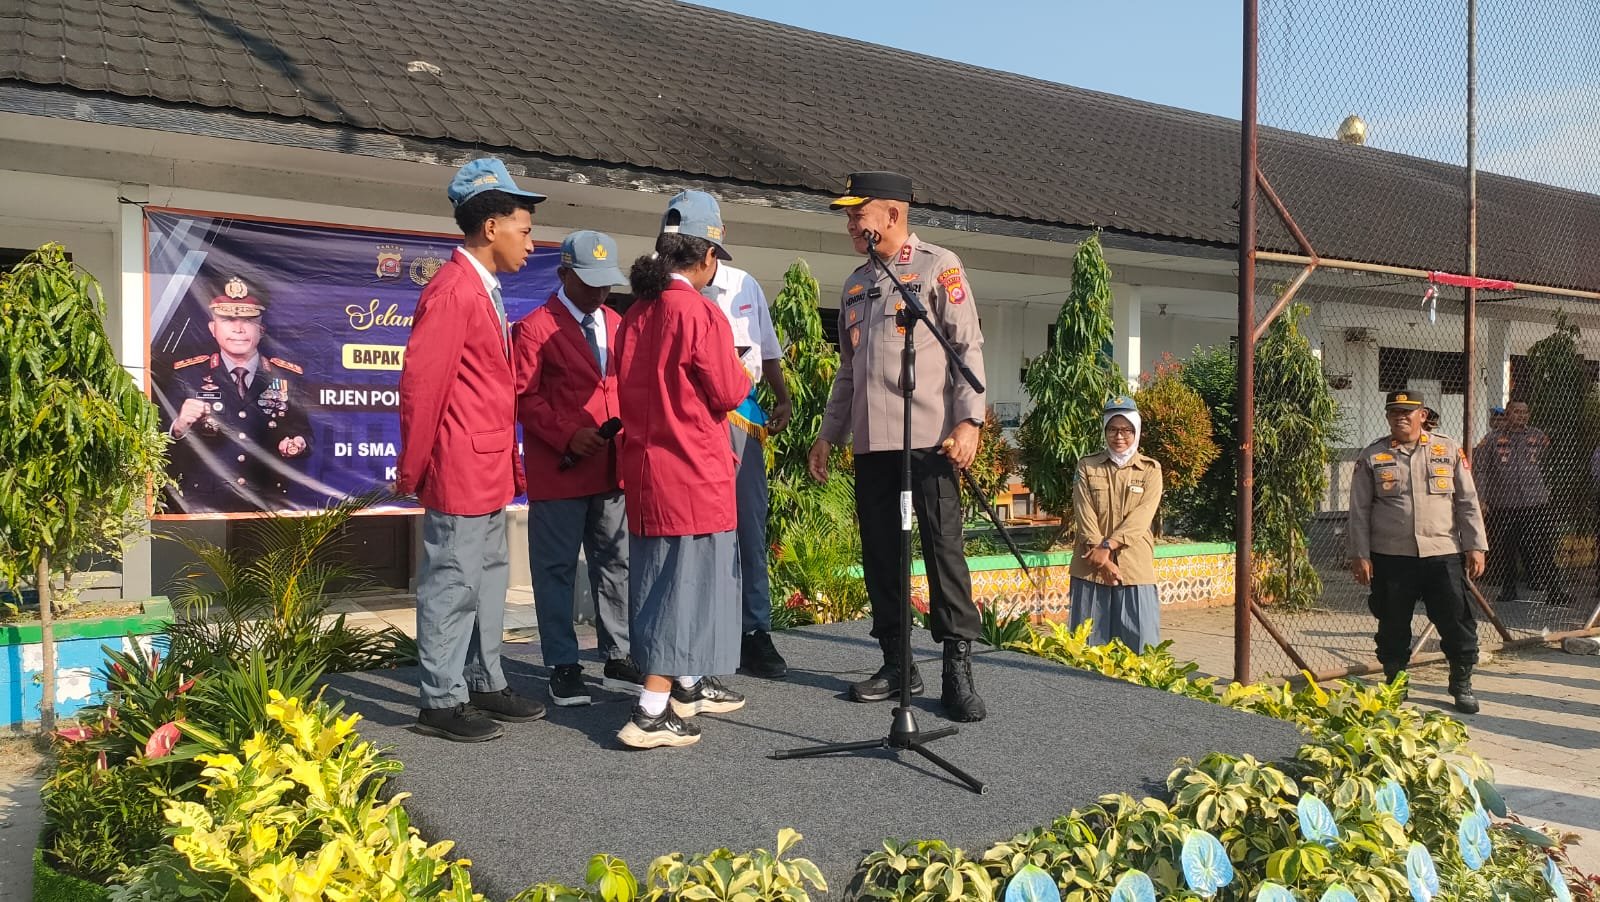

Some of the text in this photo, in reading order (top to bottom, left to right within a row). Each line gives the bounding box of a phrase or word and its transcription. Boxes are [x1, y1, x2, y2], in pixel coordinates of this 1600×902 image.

[353, 349, 400, 365] BAPAK
[320, 389, 368, 406] IRJEN
[334, 442, 397, 457] Di SMA
